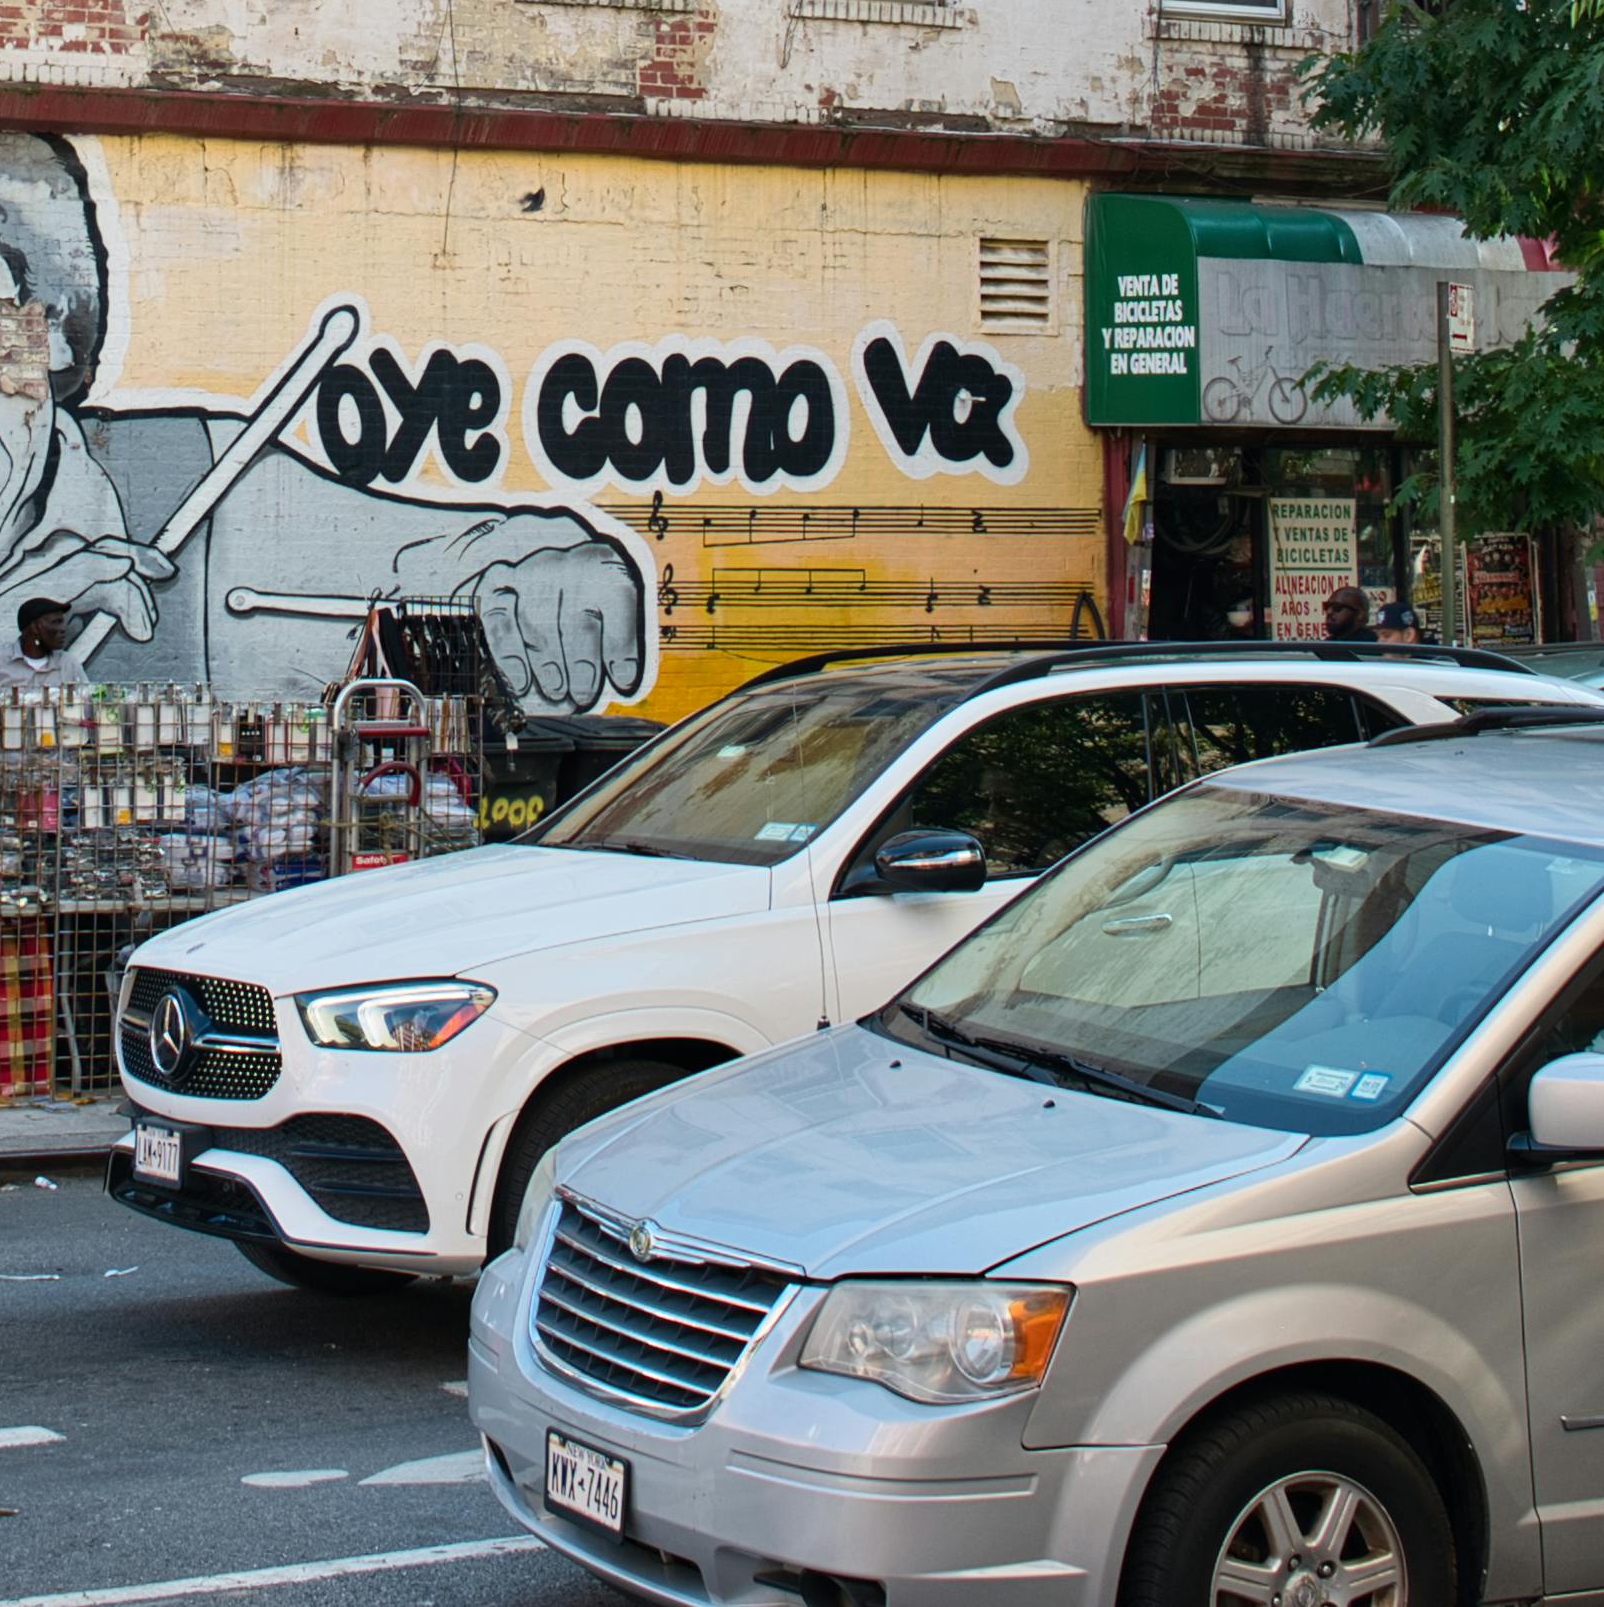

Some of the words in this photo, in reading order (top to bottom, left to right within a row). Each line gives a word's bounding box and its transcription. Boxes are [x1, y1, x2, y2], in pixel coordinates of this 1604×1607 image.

[1117, 274, 1160, 297] VENTA
[1161, 273, 1179, 296] DE
[1114, 299, 1183, 323] BICICLETAS
[1101, 327, 1112, 349] Y
[1114, 326, 1195, 349] REPARACION
[1110, 353, 1128, 375] EN
[1130, 352, 1187, 374] GENERAL
[316, 346, 502, 485] oye
[536, 352, 836, 486] como
[1273, 504, 1351, 519] REPARACION
[1284, 527, 1329, 541] VENTAS
[1334, 527, 1349, 541] DE
[1277, 548, 1349, 563] BICICLETAS
[1275, 575, 1334, 595] ALINEACION
[1276, 622, 1291, 637] EN
